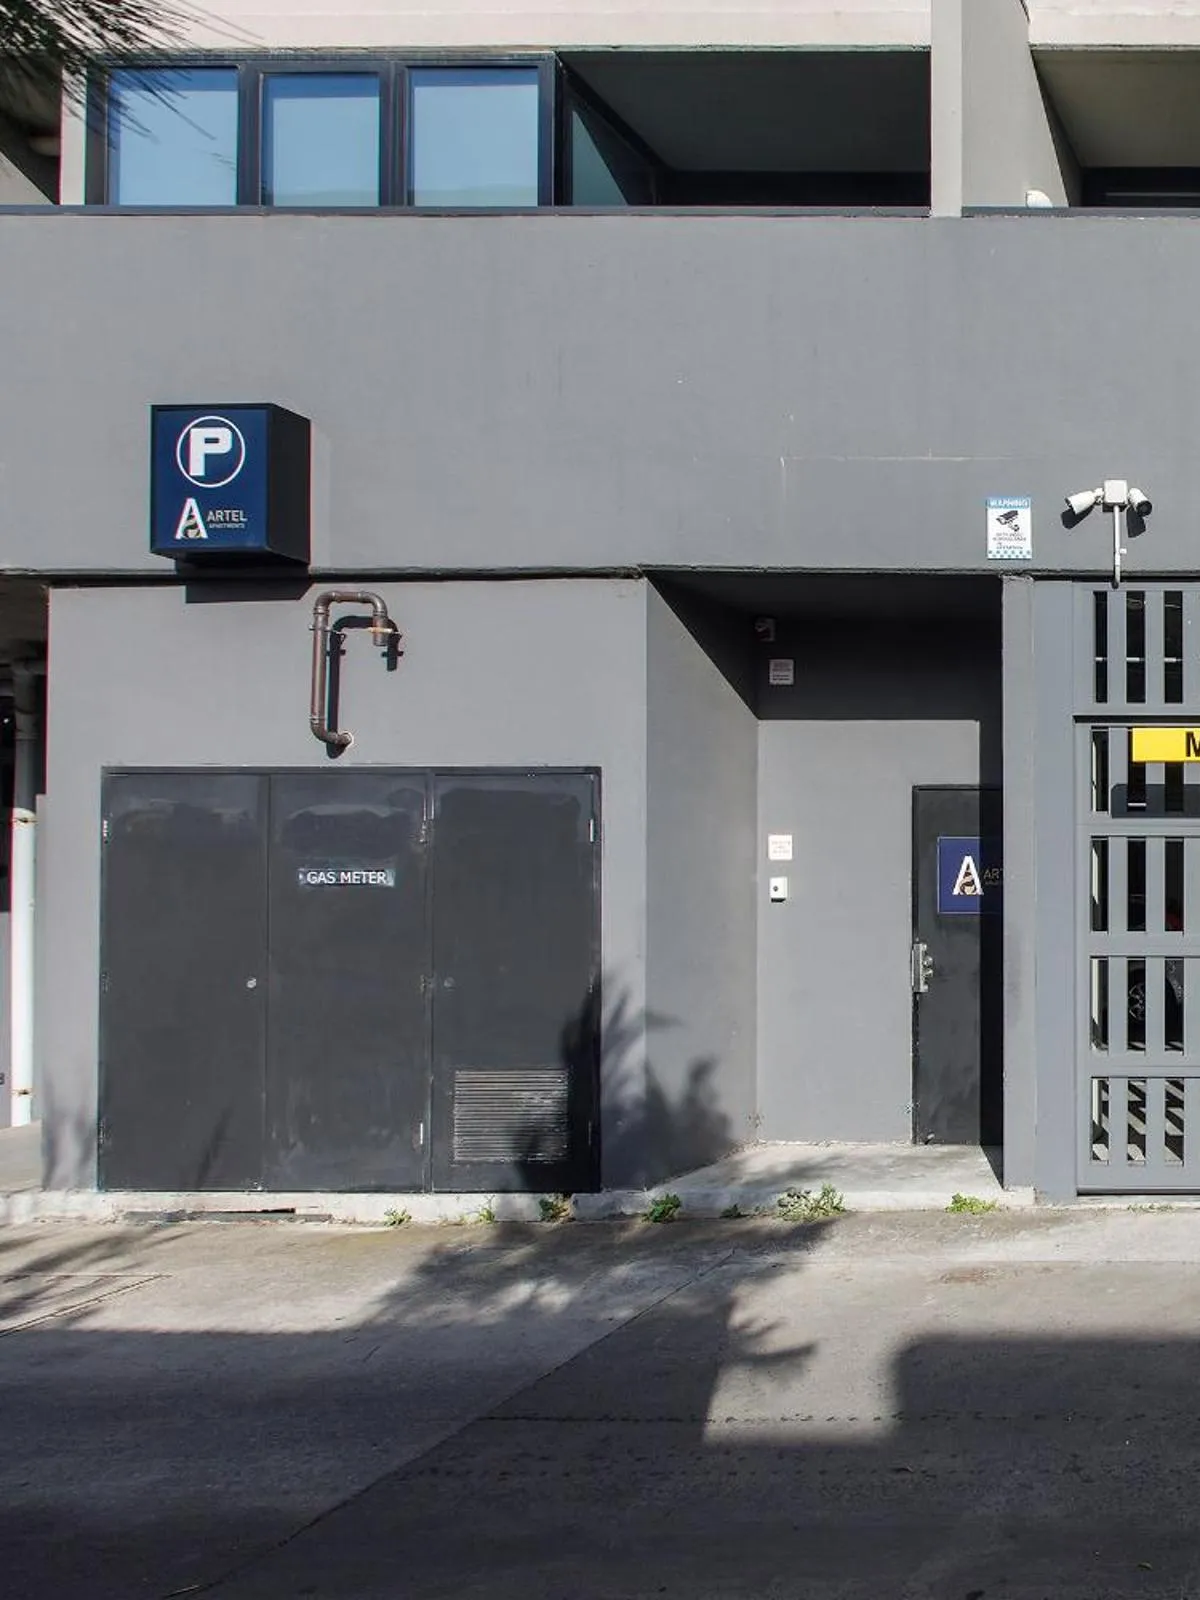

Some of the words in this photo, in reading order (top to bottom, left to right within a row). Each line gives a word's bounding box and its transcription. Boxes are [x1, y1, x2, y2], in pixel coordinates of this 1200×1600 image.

[189, 427, 232, 477] P
[207, 509, 248, 522] ARTEL
[306, 871, 337, 884] GAS
[340, 871, 387, 884] METER
